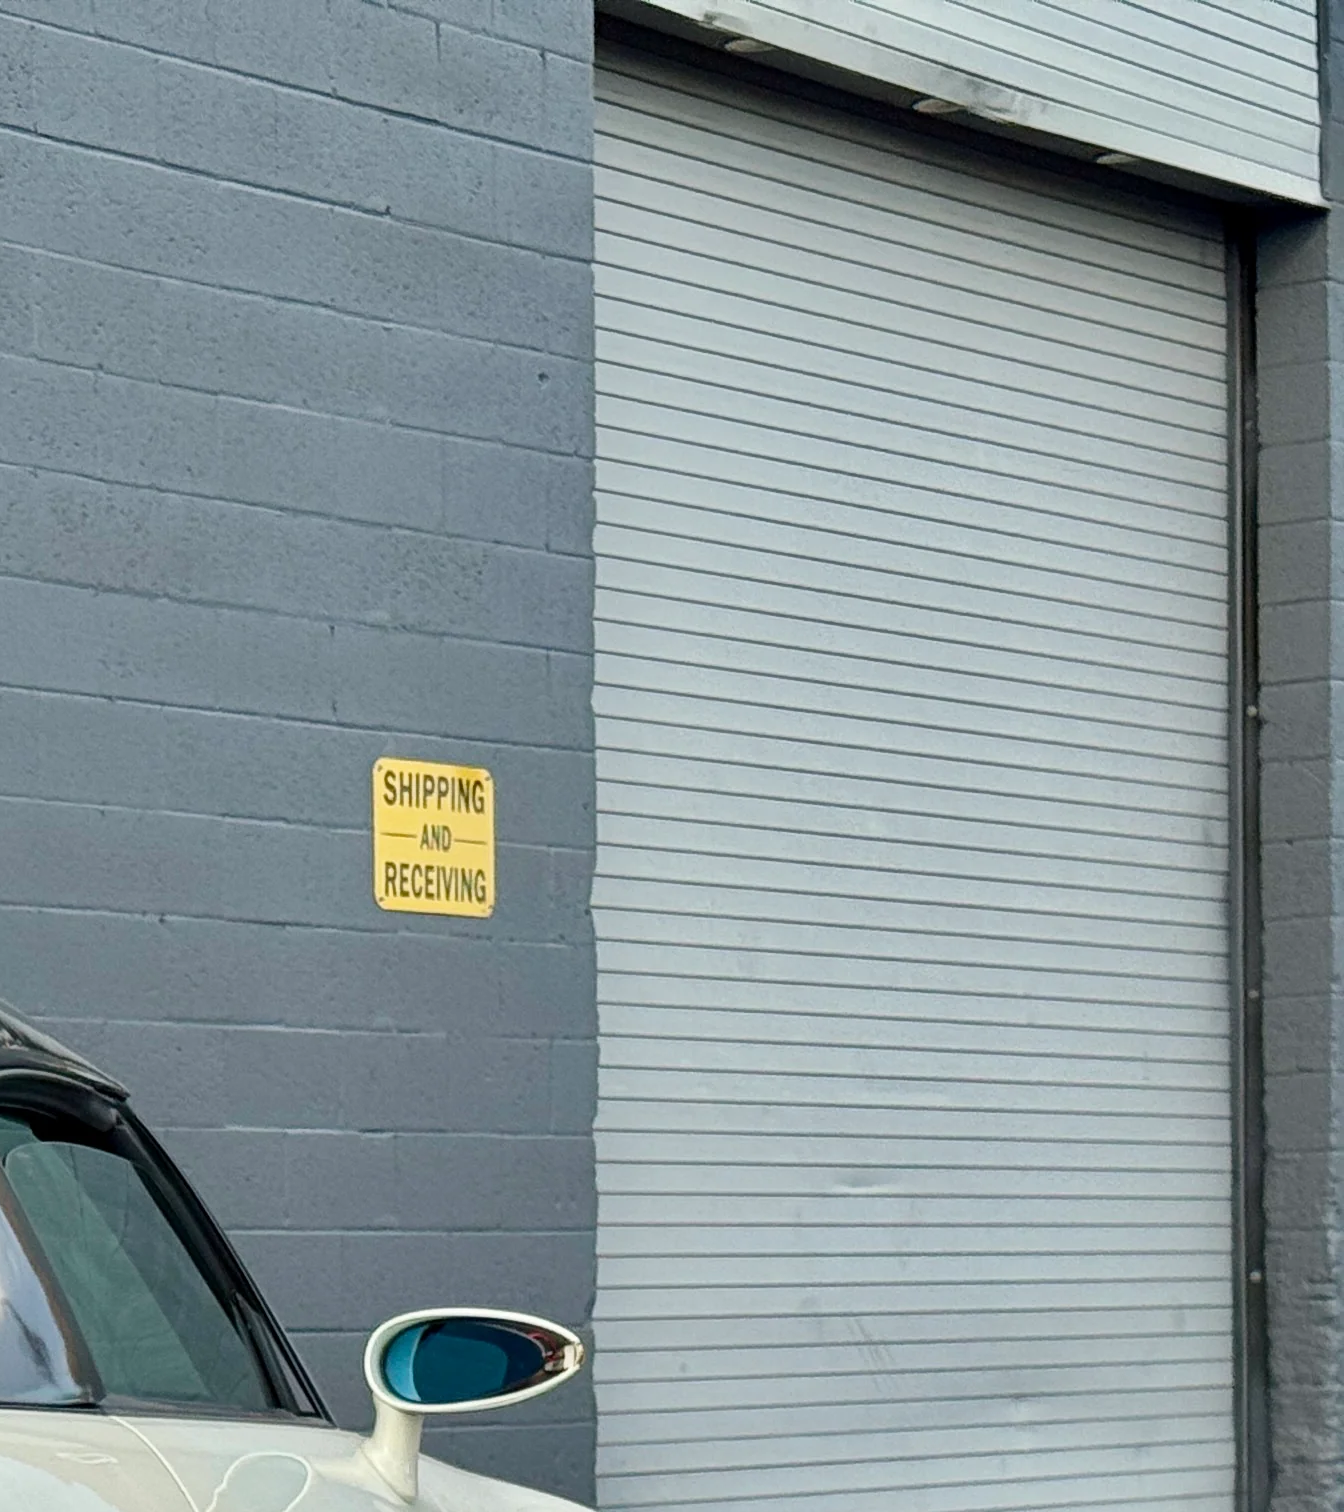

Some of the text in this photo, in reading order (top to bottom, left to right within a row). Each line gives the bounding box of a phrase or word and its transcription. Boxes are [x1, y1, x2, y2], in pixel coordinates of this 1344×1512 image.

[383, 769, 486, 815] SHIPPING
[420, 823, 453, 853] AND
[384, 861, 487, 905] RECEIVING
